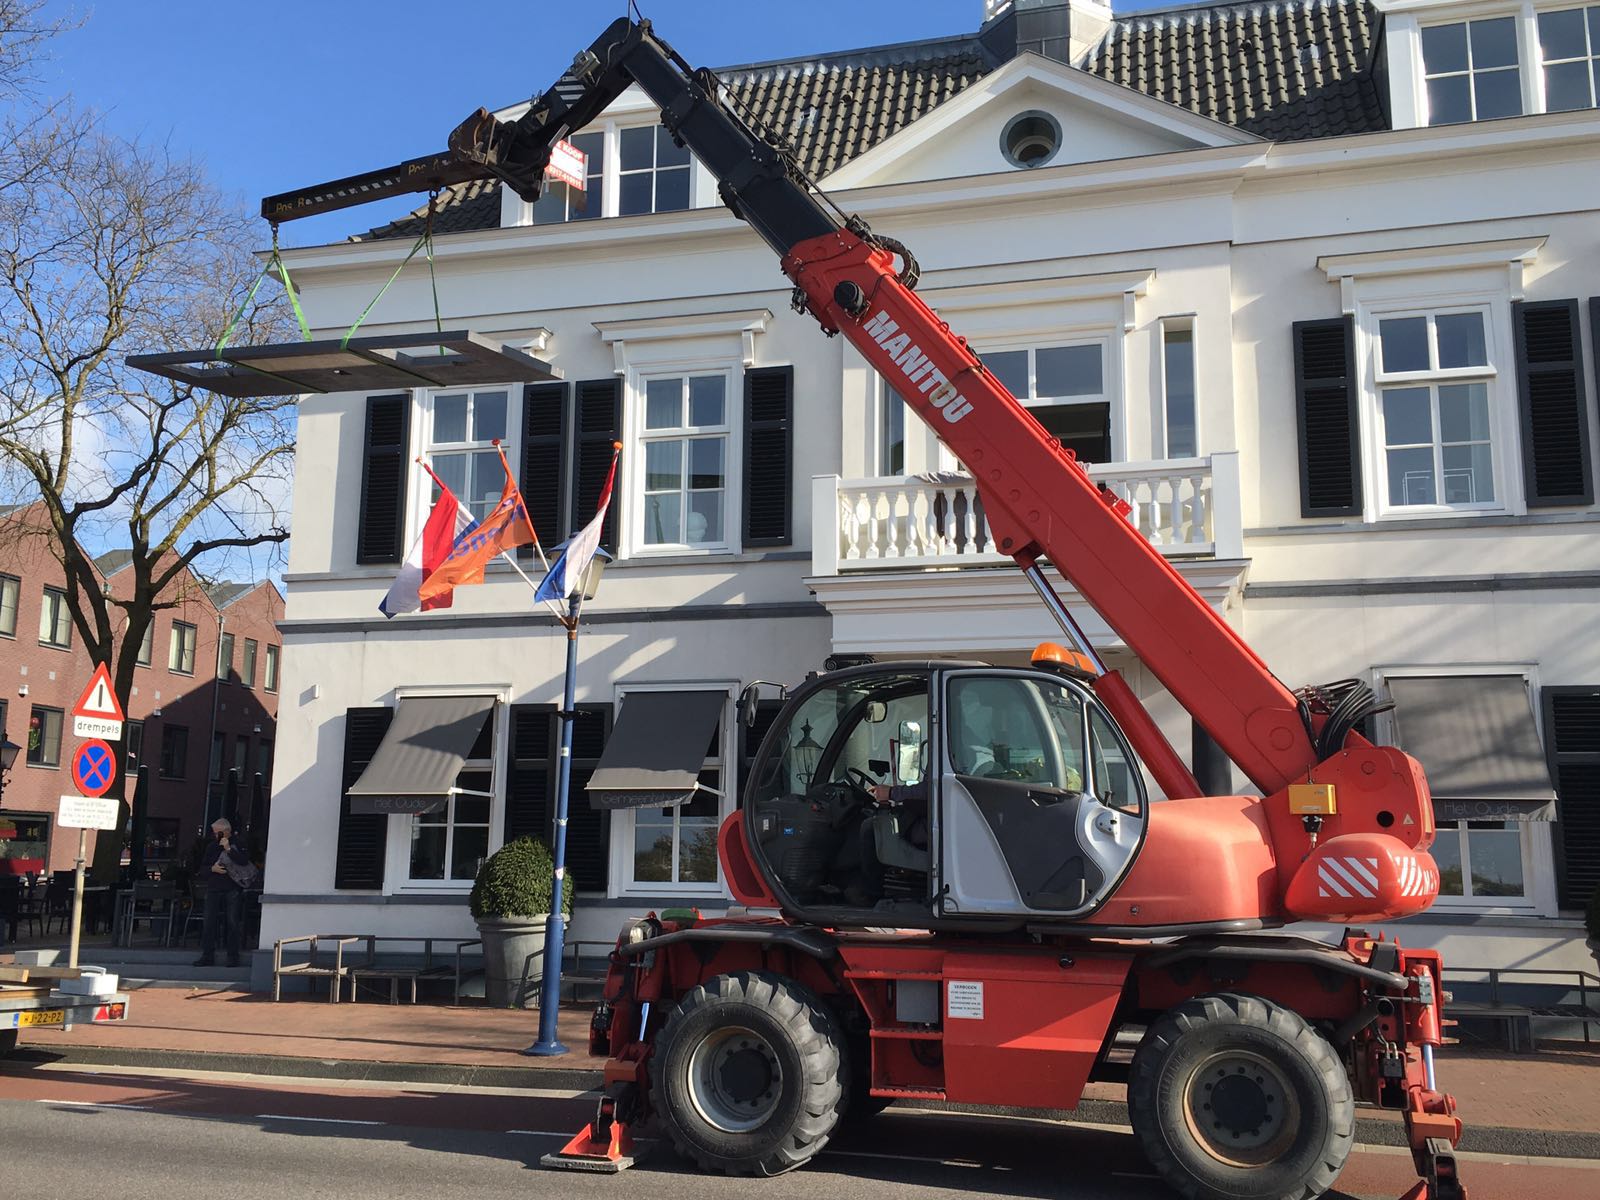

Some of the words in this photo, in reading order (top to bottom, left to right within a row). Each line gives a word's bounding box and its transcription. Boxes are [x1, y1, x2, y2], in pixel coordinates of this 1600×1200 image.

[862, 309, 975, 424] MANITOU
[77, 721, 120, 735] drempels
[1444, 801, 1469, 815] Het
